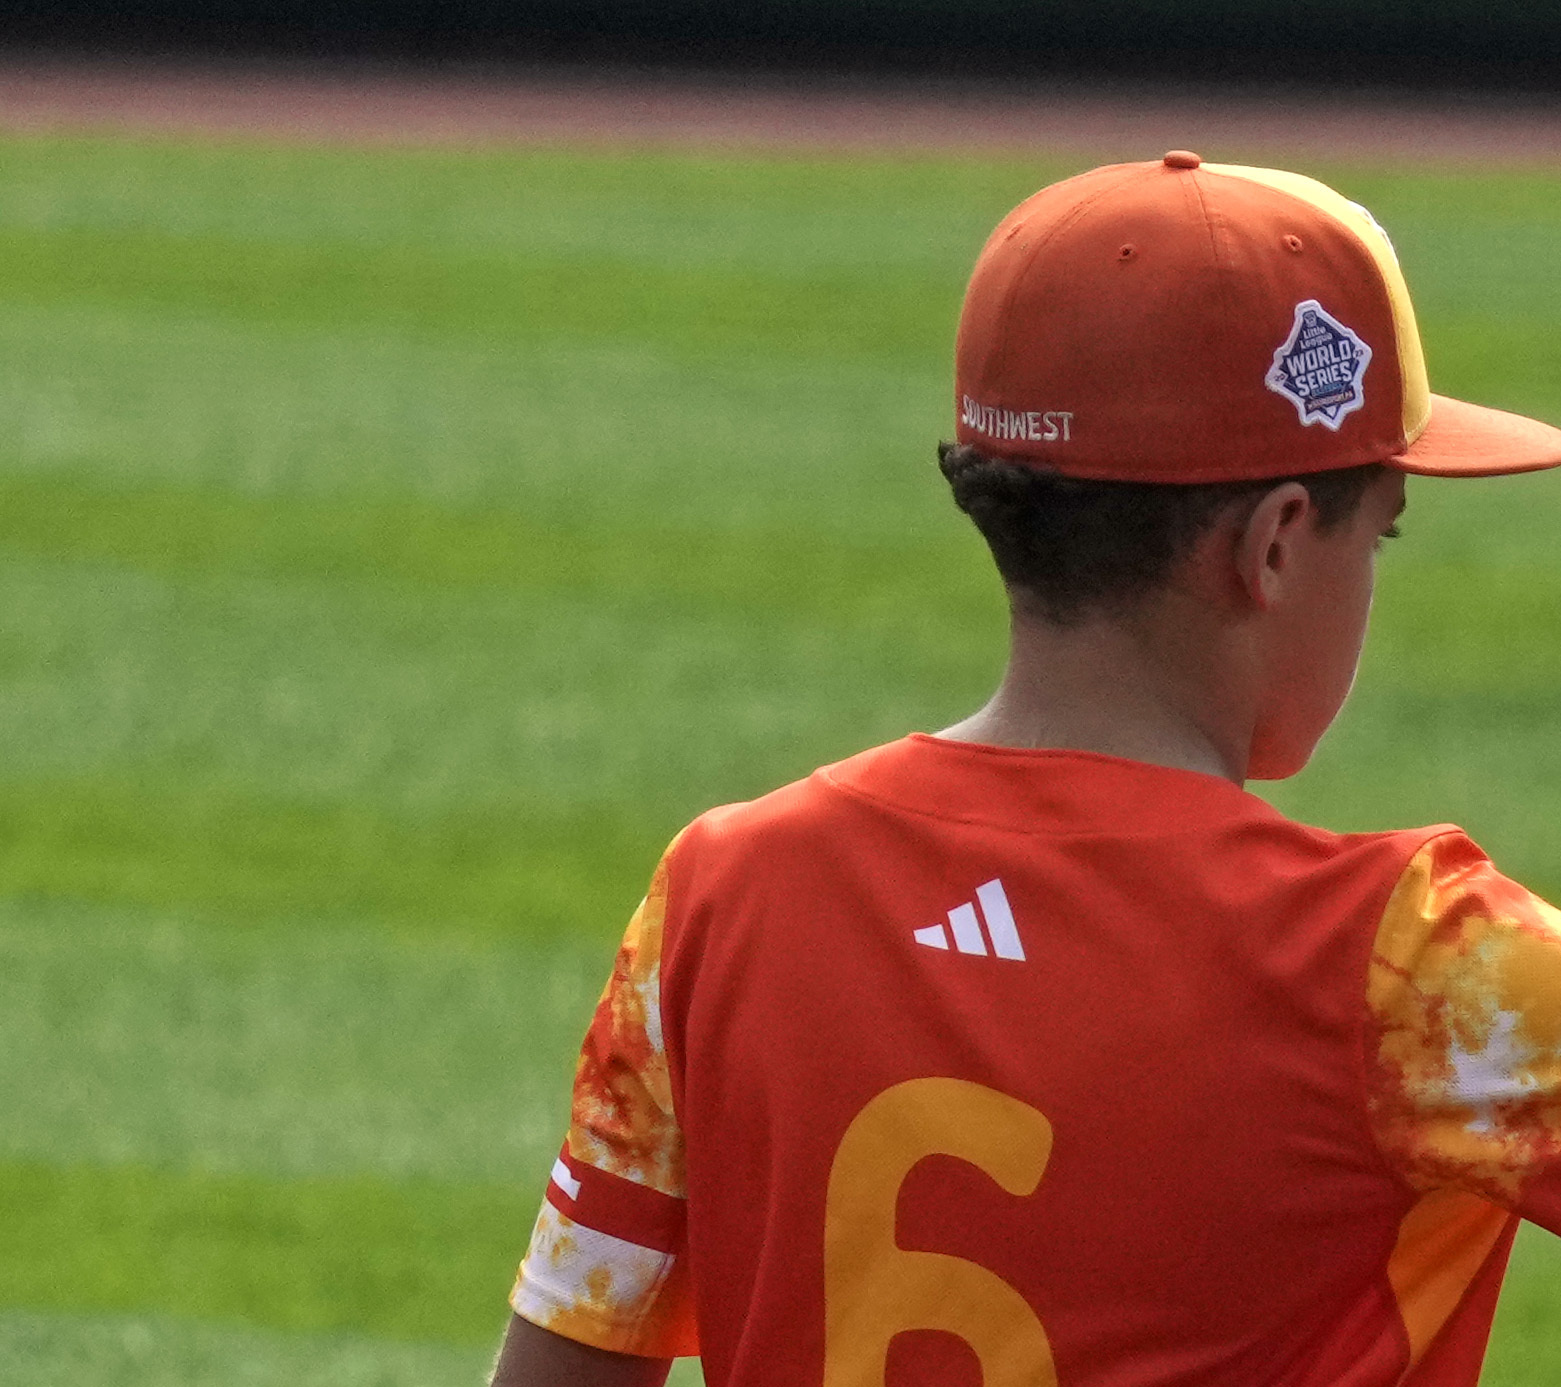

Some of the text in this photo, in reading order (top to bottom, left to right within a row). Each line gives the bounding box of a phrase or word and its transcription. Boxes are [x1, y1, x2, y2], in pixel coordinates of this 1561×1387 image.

[1286, 340, 1352, 377] WORLD
[1295, 360, 1353, 397] SERIES
[962, 394, 1073, 441] SOUTHWEST
